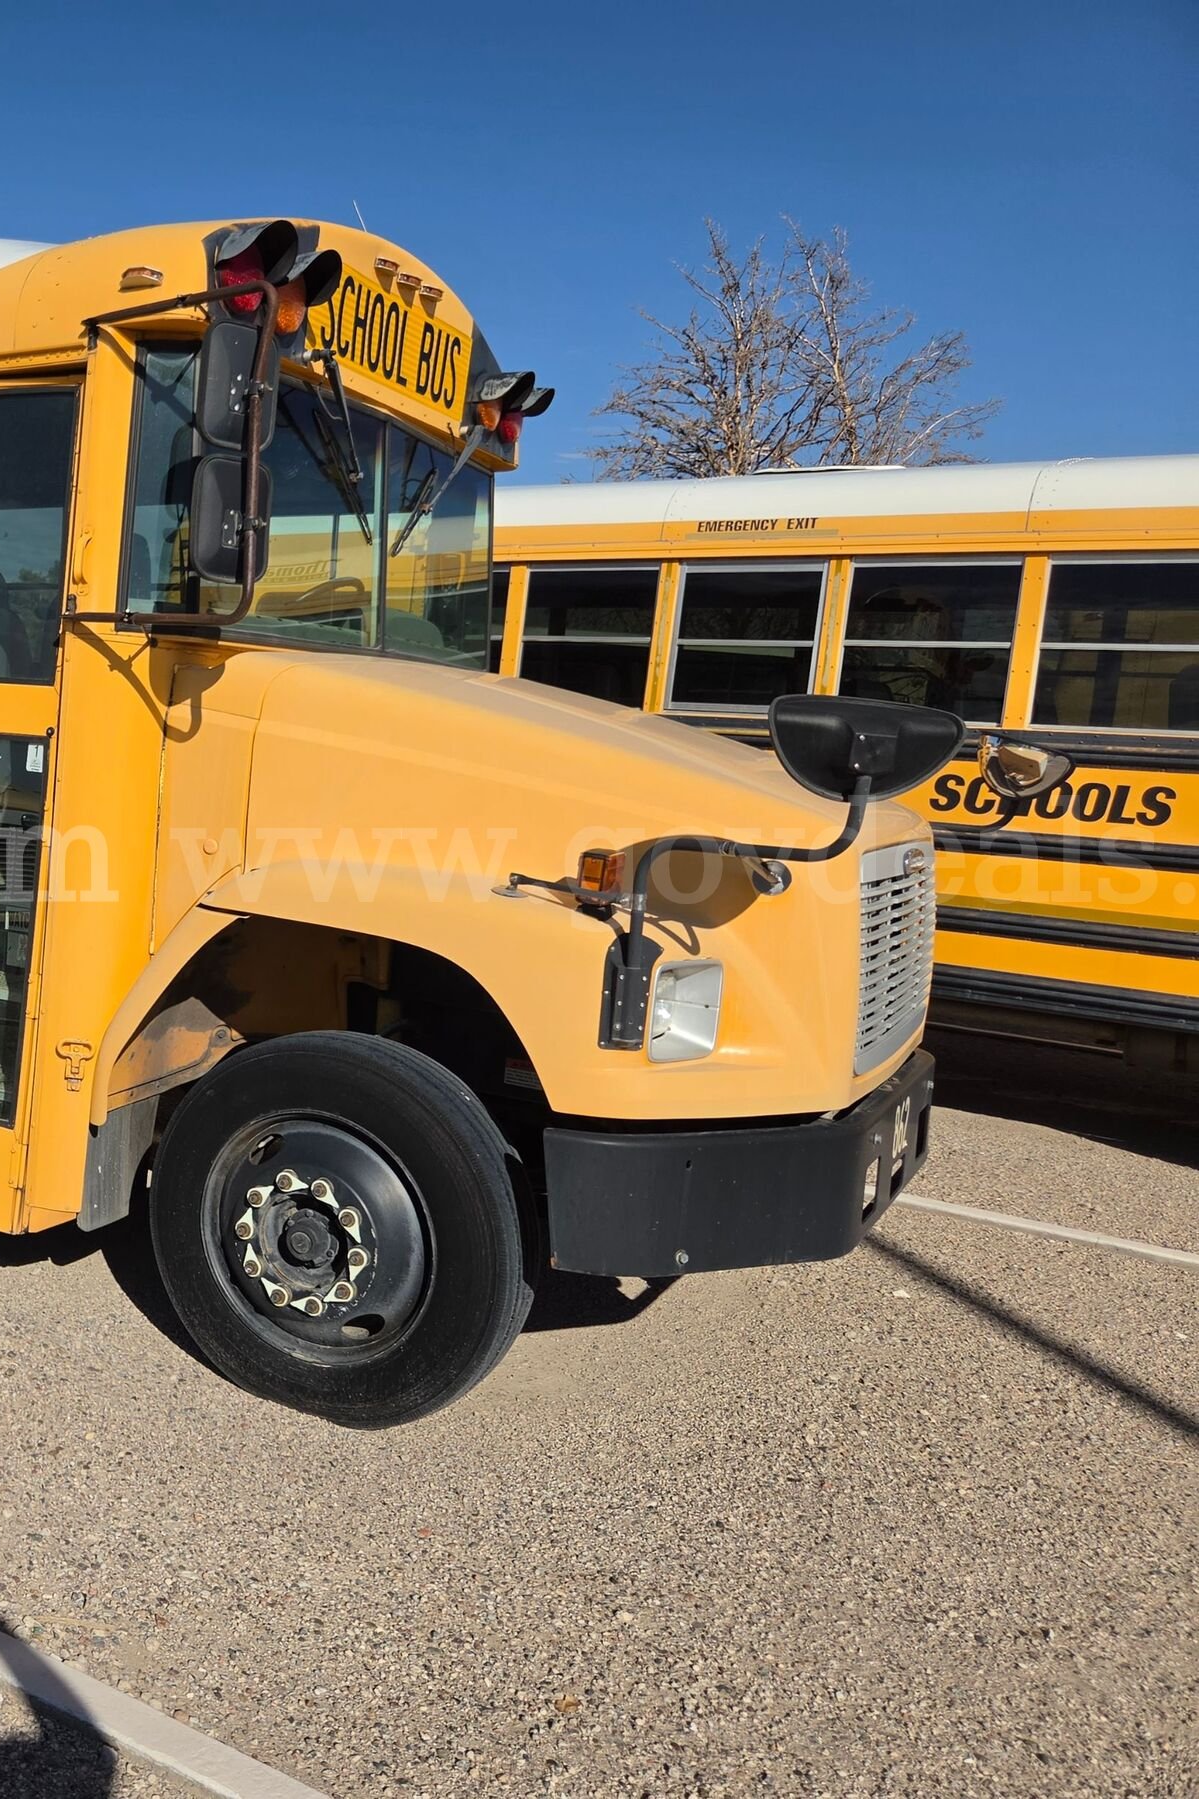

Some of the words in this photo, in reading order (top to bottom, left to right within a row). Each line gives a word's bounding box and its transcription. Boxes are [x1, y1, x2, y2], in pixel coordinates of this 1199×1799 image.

[415, 321, 461, 410] BUS
[697, 518, 779, 533] EMERGENCY
[786, 517, 819, 530] EXIT
[892, 1095, 911, 1159] 862
